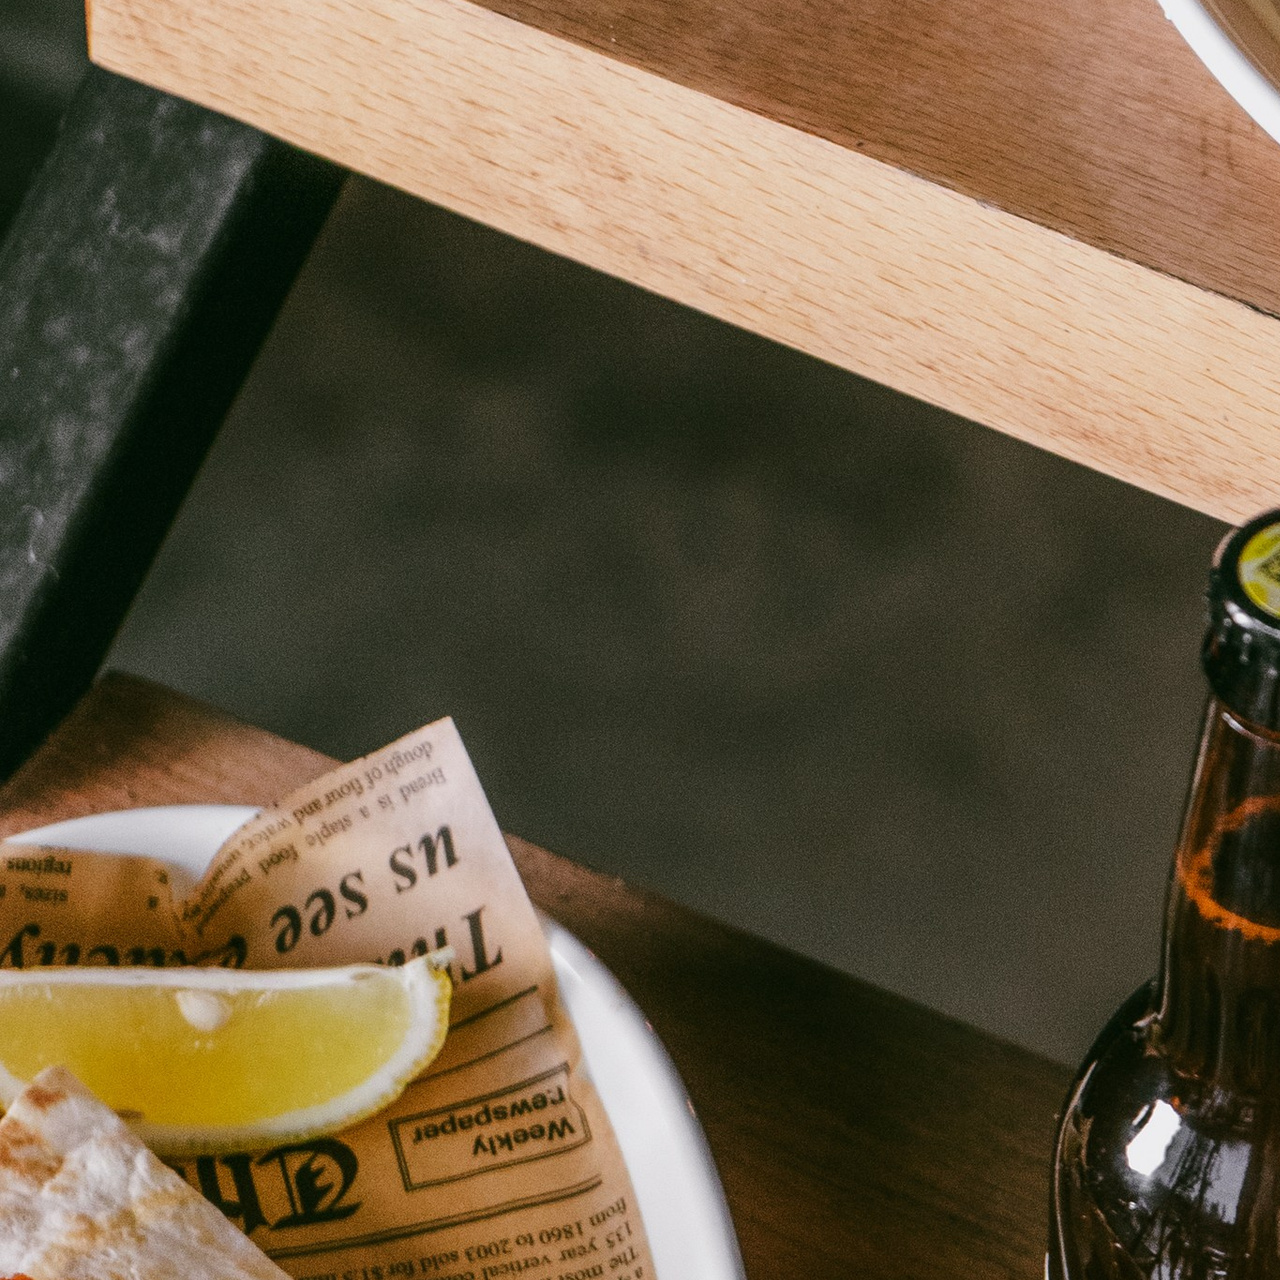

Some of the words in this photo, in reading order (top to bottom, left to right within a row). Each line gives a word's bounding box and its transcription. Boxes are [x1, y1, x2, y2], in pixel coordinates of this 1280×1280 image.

[383, 741, 435, 778] dough
[361, 766, 383, 790] of
[398, 766, 448, 804] Bread
[291, 797, 322, 827] and
[359, 804, 370, 820] a
[376, 793, 393, 812] is
[303, 813, 354, 850] staple
[6, 855, 72, 877] regions
[257, 842, 299, 876] food
[387, 822, 462, 896] us
[269, 869, 370, 958] see
[411, 1085, 567, 1146] newspaper
[471, 1115, 577, 1160] Weekly
[588, 1197, 628, 1229] from
[515, 1232, 535, 1247] to
[539, 1219, 584, 1246] 1860
[605, 1220, 633, 1249] 135
[419, 1250, 459, 1274] sold
[464, 1237, 511, 1262] 2003
[559, 1236, 598, 1262] year
[609, 1245, 639, 1270] The
[387, 1260, 415, 1279] for
[634, 1266, 643, 1280] a
